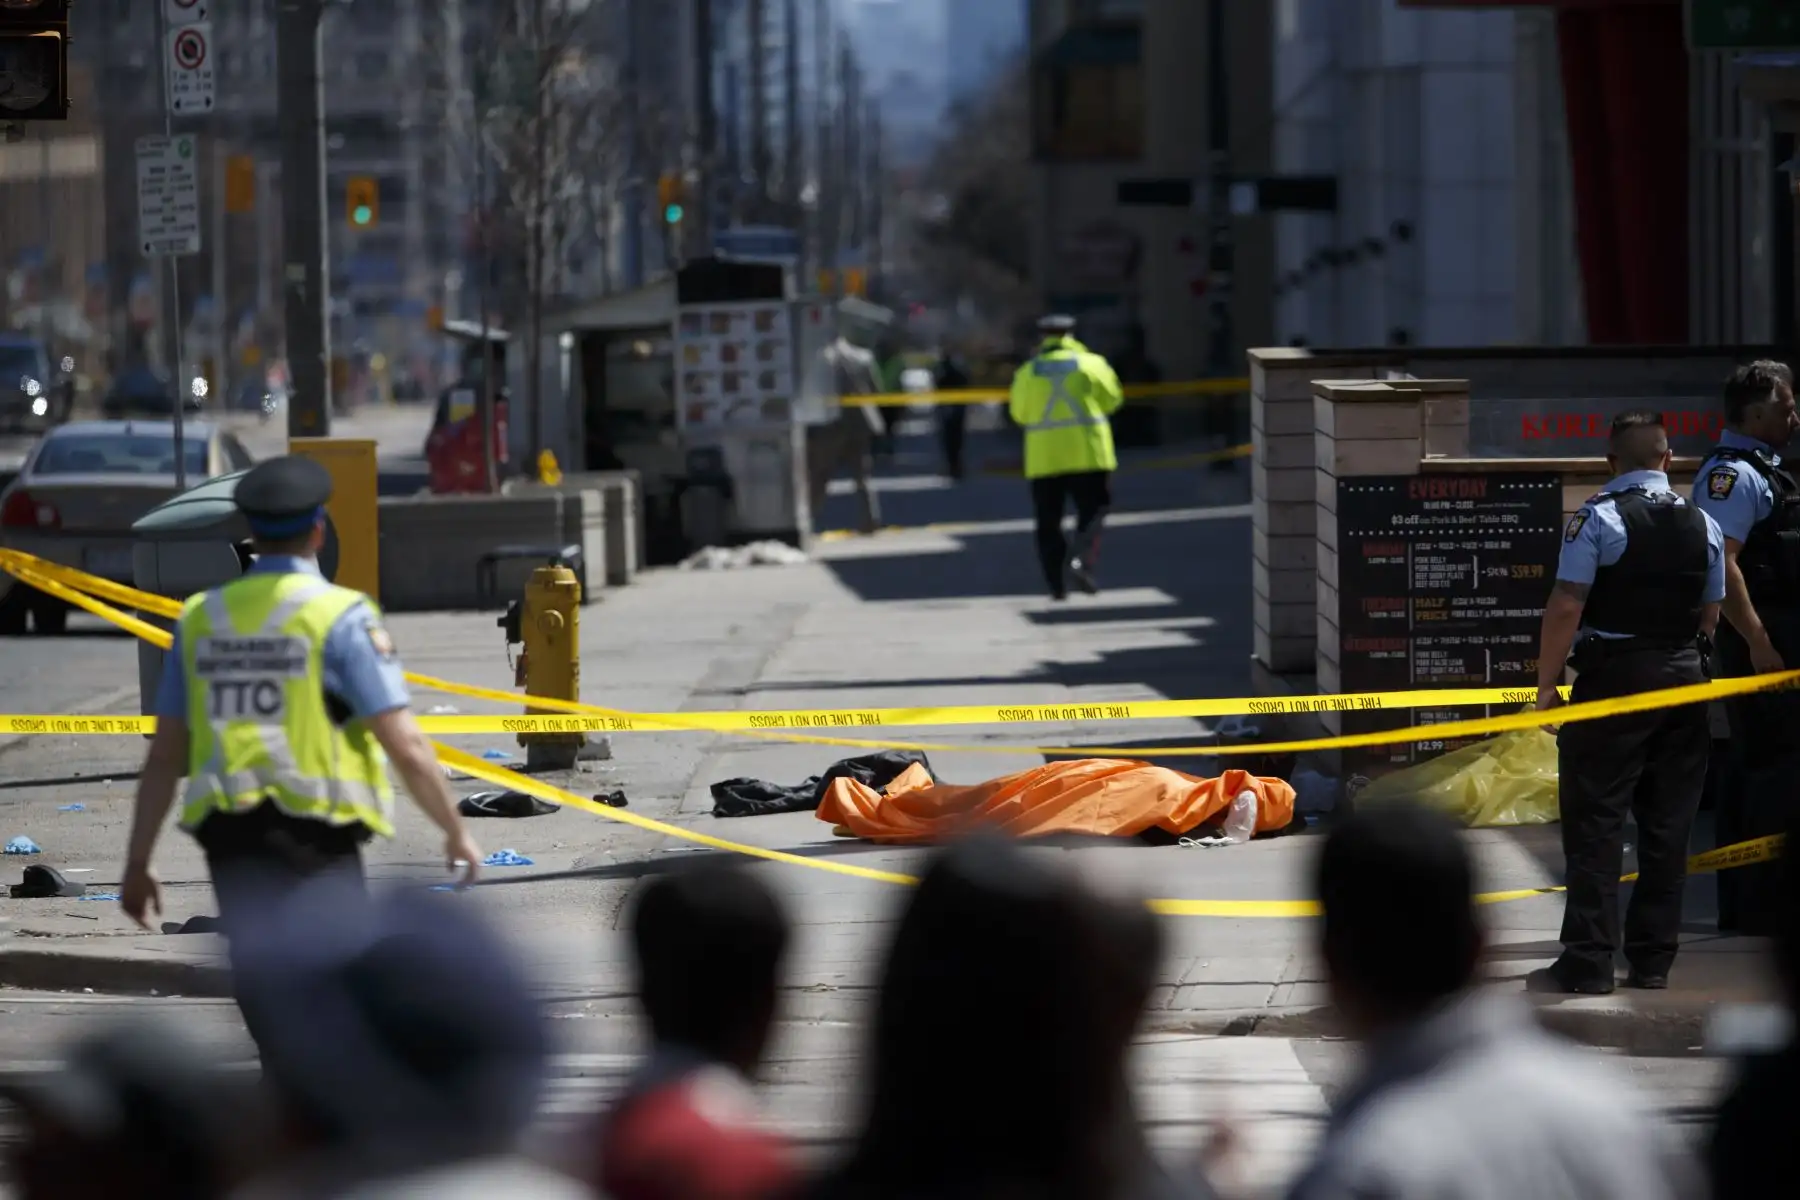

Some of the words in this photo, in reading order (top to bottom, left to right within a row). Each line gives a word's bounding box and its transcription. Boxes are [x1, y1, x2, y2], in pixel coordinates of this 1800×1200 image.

[1522, 412, 1609, 439] KORE
[1409, 478, 1488, 499] EVERYDAY
[1391, 514, 1403, 525] $3
[1404, 514, 1419, 524] off
[1415, 598, 1445, 608] HALF
[212, 679, 281, 717] TTC
[1330, 697, 1355, 711] LINE
[1358, 696, 1382, 710] FIRE
[1078, 707, 1103, 720] LINE
[1106, 706, 1130, 719] FIRE
[1248, 700, 1284, 714] CROSS
[749, 715, 784, 728] CROSS
[790, 715, 810, 727] NOT
[813, 714, 828, 726] DO
[830, 714, 853, 726] LINE
[856, 712, 881, 725] FIRE
[997, 708, 1034, 722] CROSS
[502, 719, 537, 732] CROSS
[582, 718, 606, 731] LINE
[1417, 740, 1443, 751] $2.99
